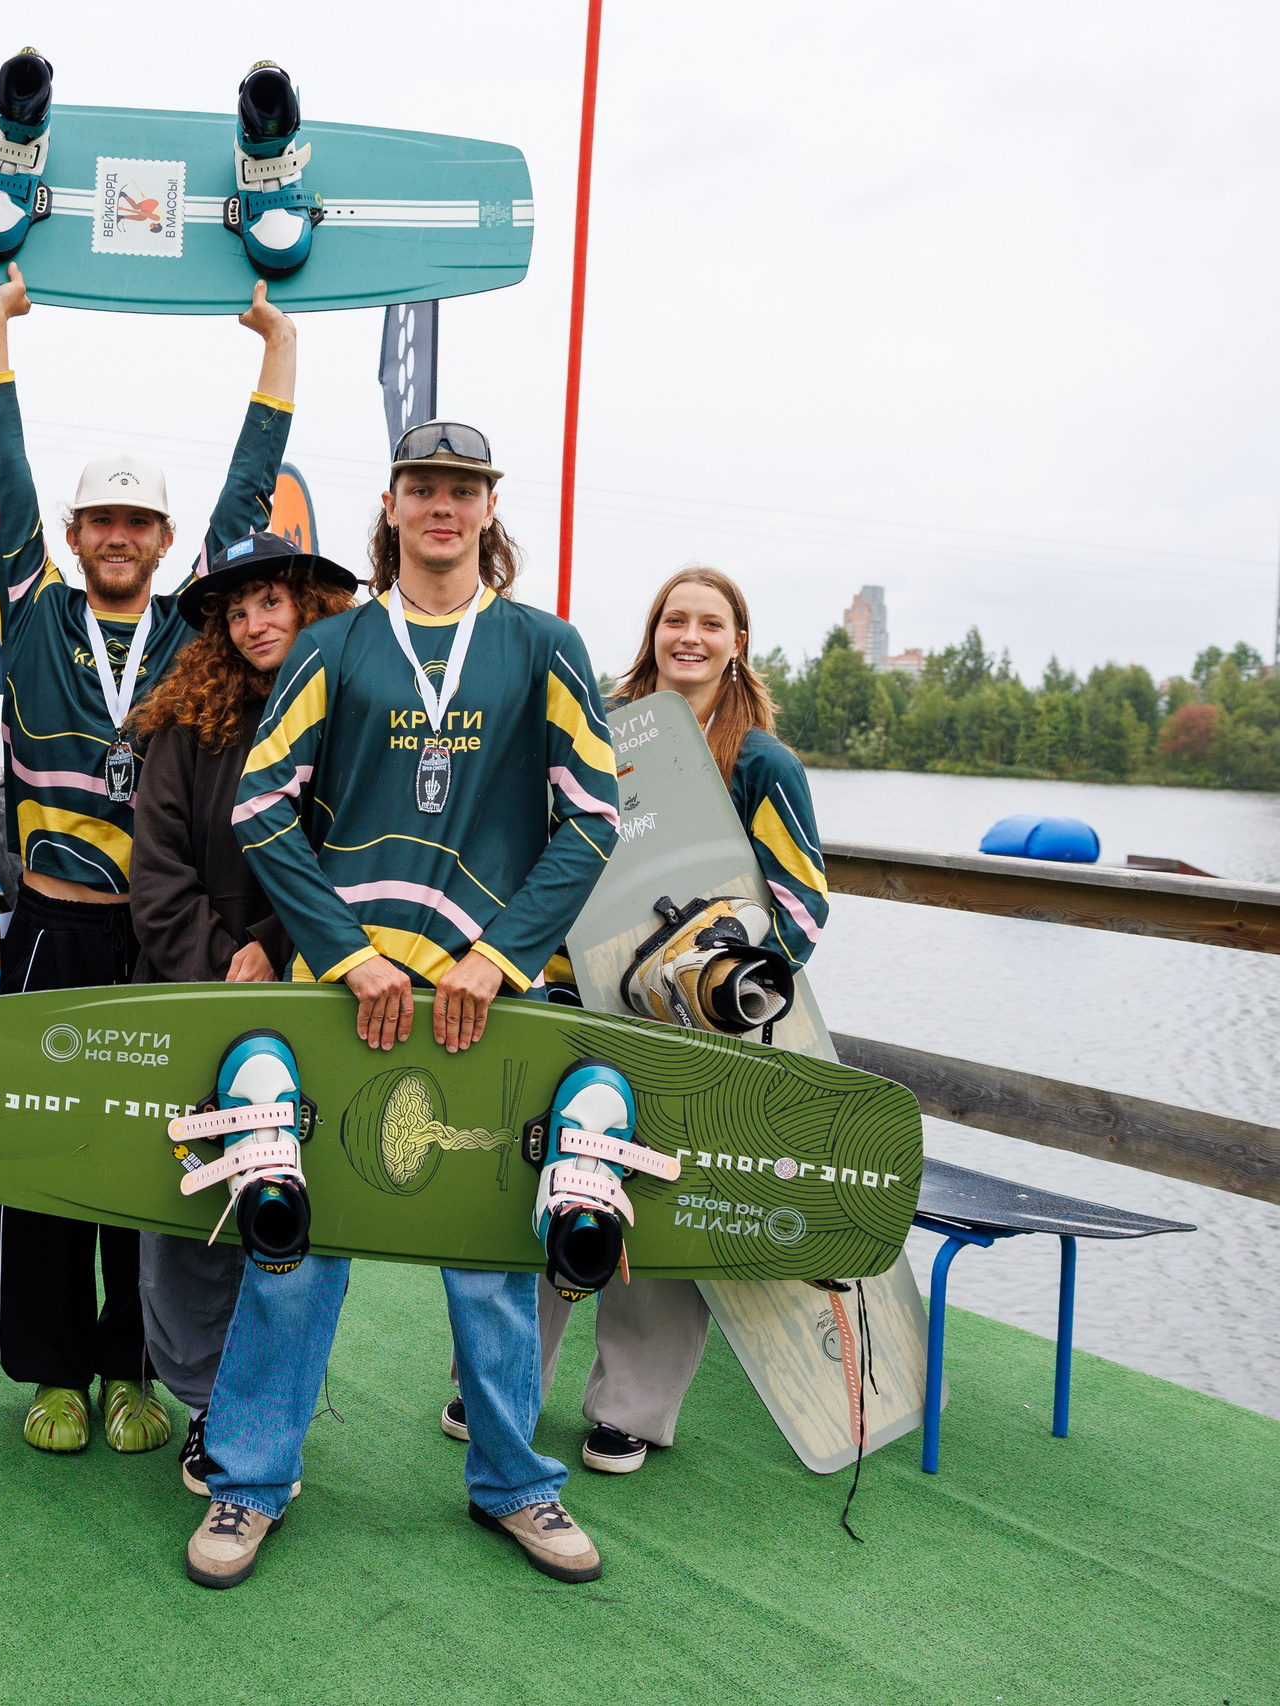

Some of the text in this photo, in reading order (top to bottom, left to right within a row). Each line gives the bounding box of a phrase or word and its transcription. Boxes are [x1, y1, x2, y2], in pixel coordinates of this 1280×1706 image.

[102, 173, 118, 237] ВЕЙКБОРД
[166, 179, 178, 238] В МАССЫ!
[390, 710, 482, 730] КРГИ
[610, 709, 655, 739] УГИ
[390, 735, 418, 750] на
[618, 727, 659, 754] воде
[86, 1028, 171, 1049] КРУГИ
[84, 1049, 169, 1067] на воде
[677, 1194, 764, 1217] на воде
[674, 1210, 760, 1237] КРУГИ
[256, 1261, 300, 1273] КРУГИ
